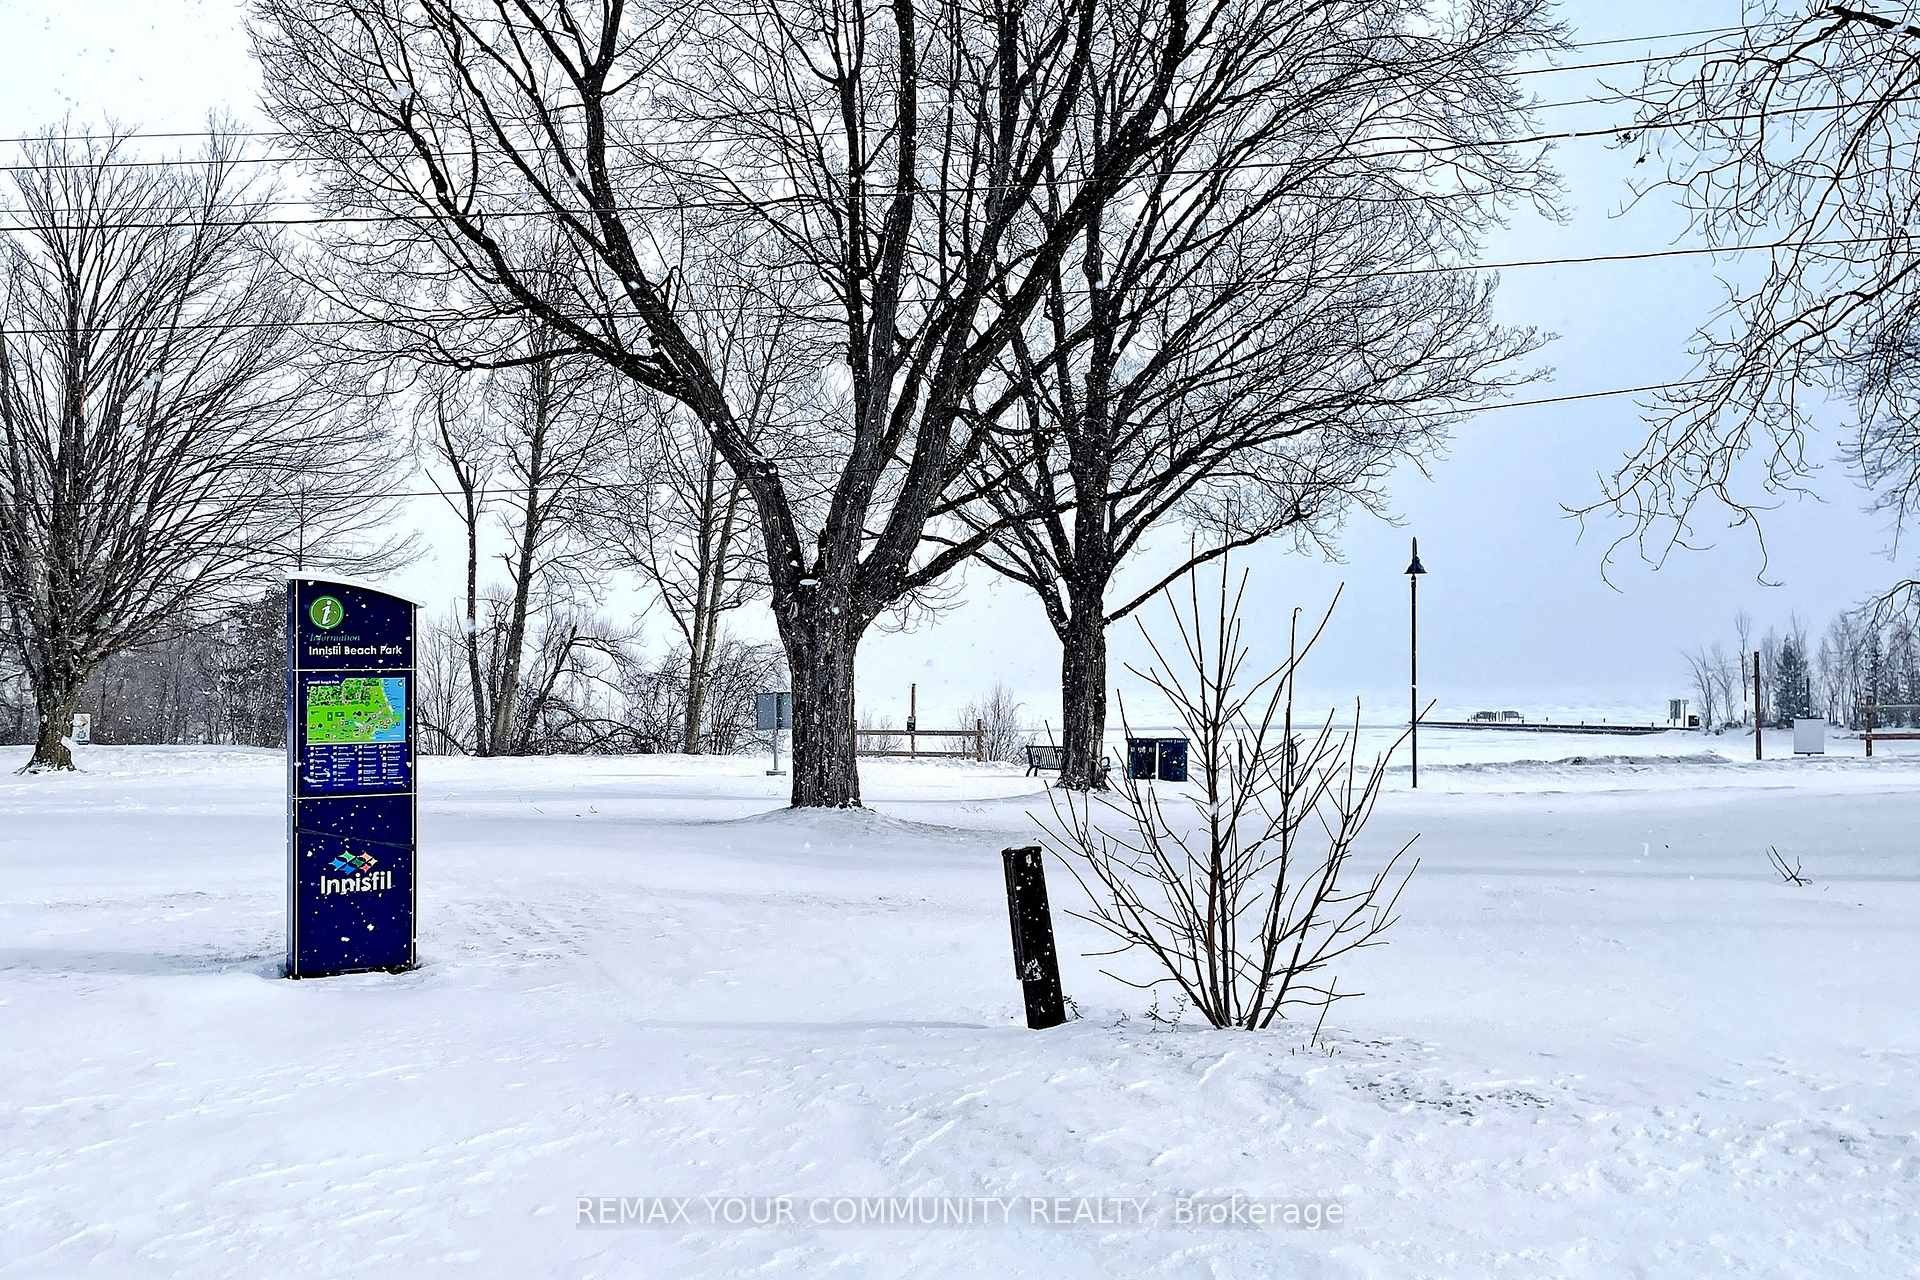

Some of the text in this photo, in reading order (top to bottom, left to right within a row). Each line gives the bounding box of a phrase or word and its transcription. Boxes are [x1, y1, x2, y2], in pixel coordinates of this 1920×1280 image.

[344, 645, 377, 655] Beach
[380, 644, 403, 655] Park
[320, 871, 392, 895] Innisfil
